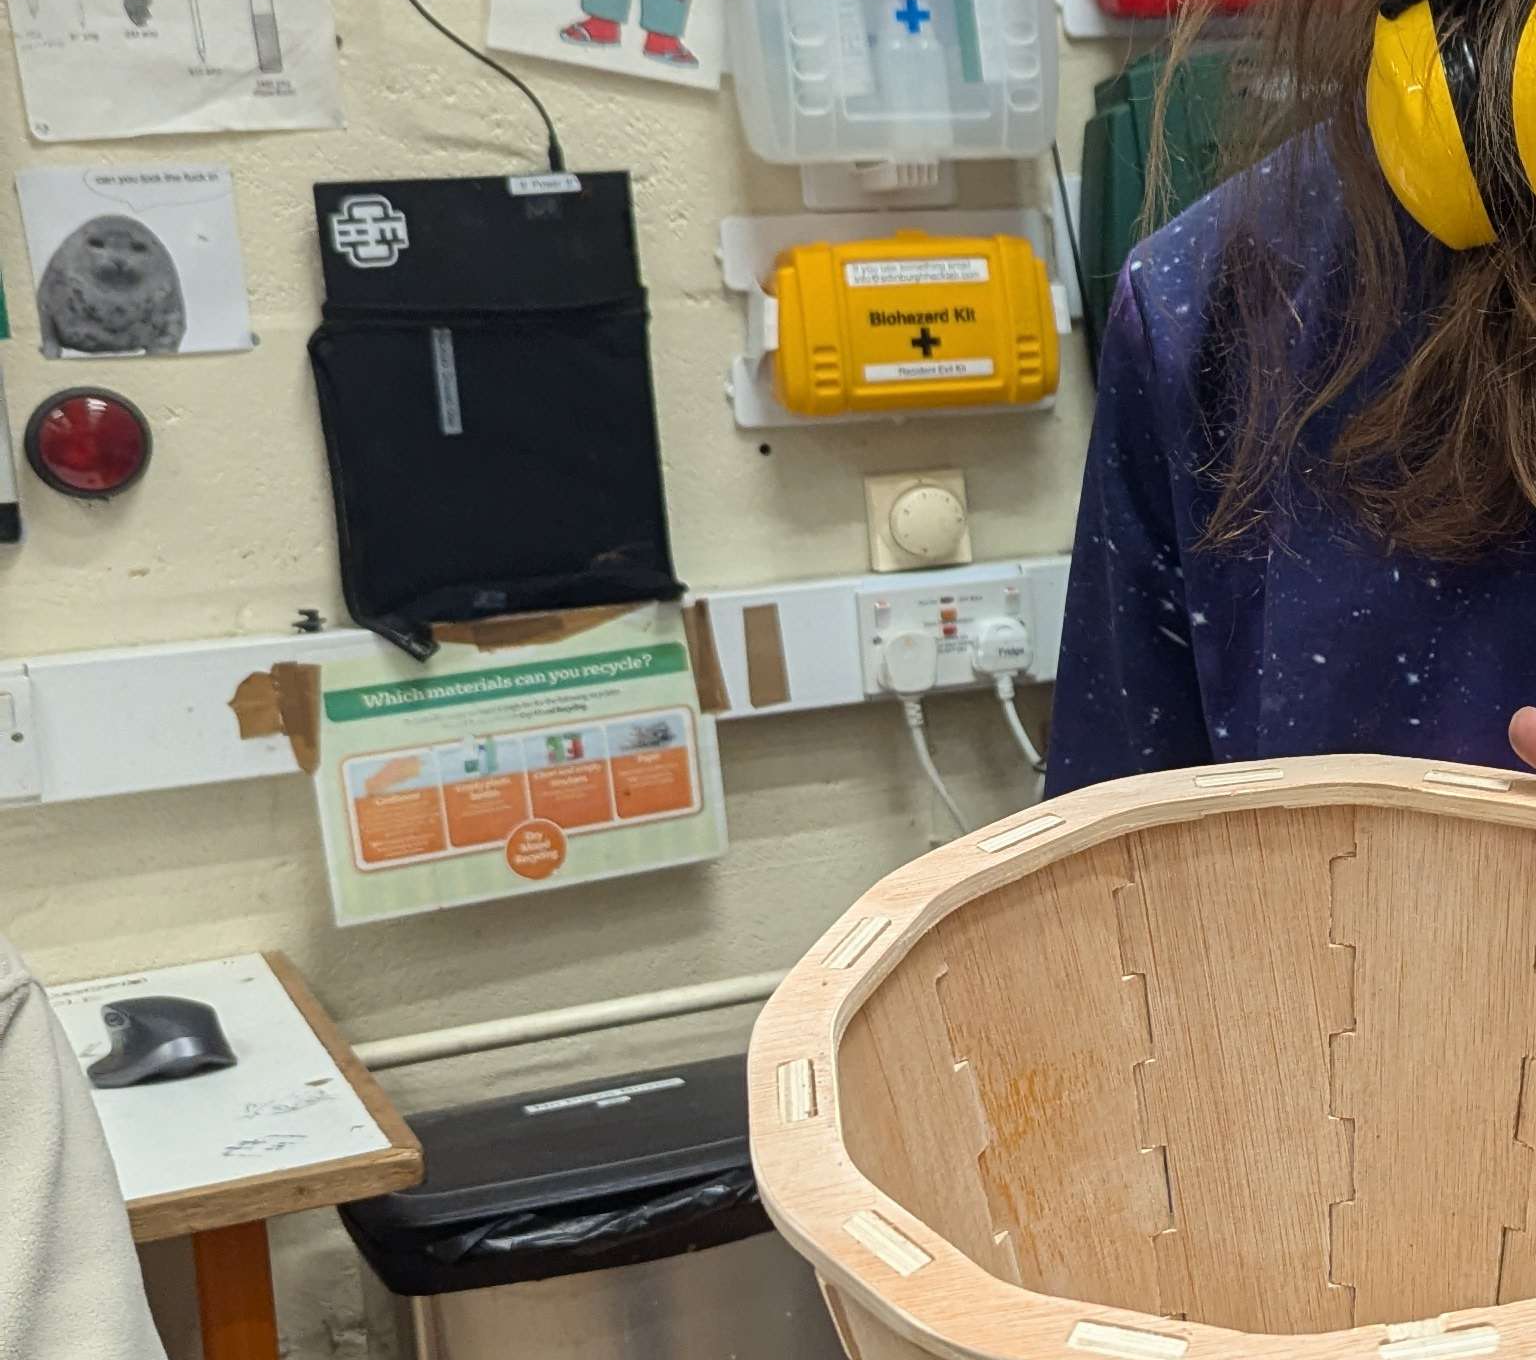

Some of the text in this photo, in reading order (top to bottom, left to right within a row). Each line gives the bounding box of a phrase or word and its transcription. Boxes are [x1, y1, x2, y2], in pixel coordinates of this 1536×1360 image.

[869, 306, 976, 326] Biohazard Kit
[362, 687, 427, 711] Which
[427, 677, 513, 700] materials
[514, 672, 546, 688] can
[548, 666, 580, 687] you
[582, 652, 653, 680] recycle?
